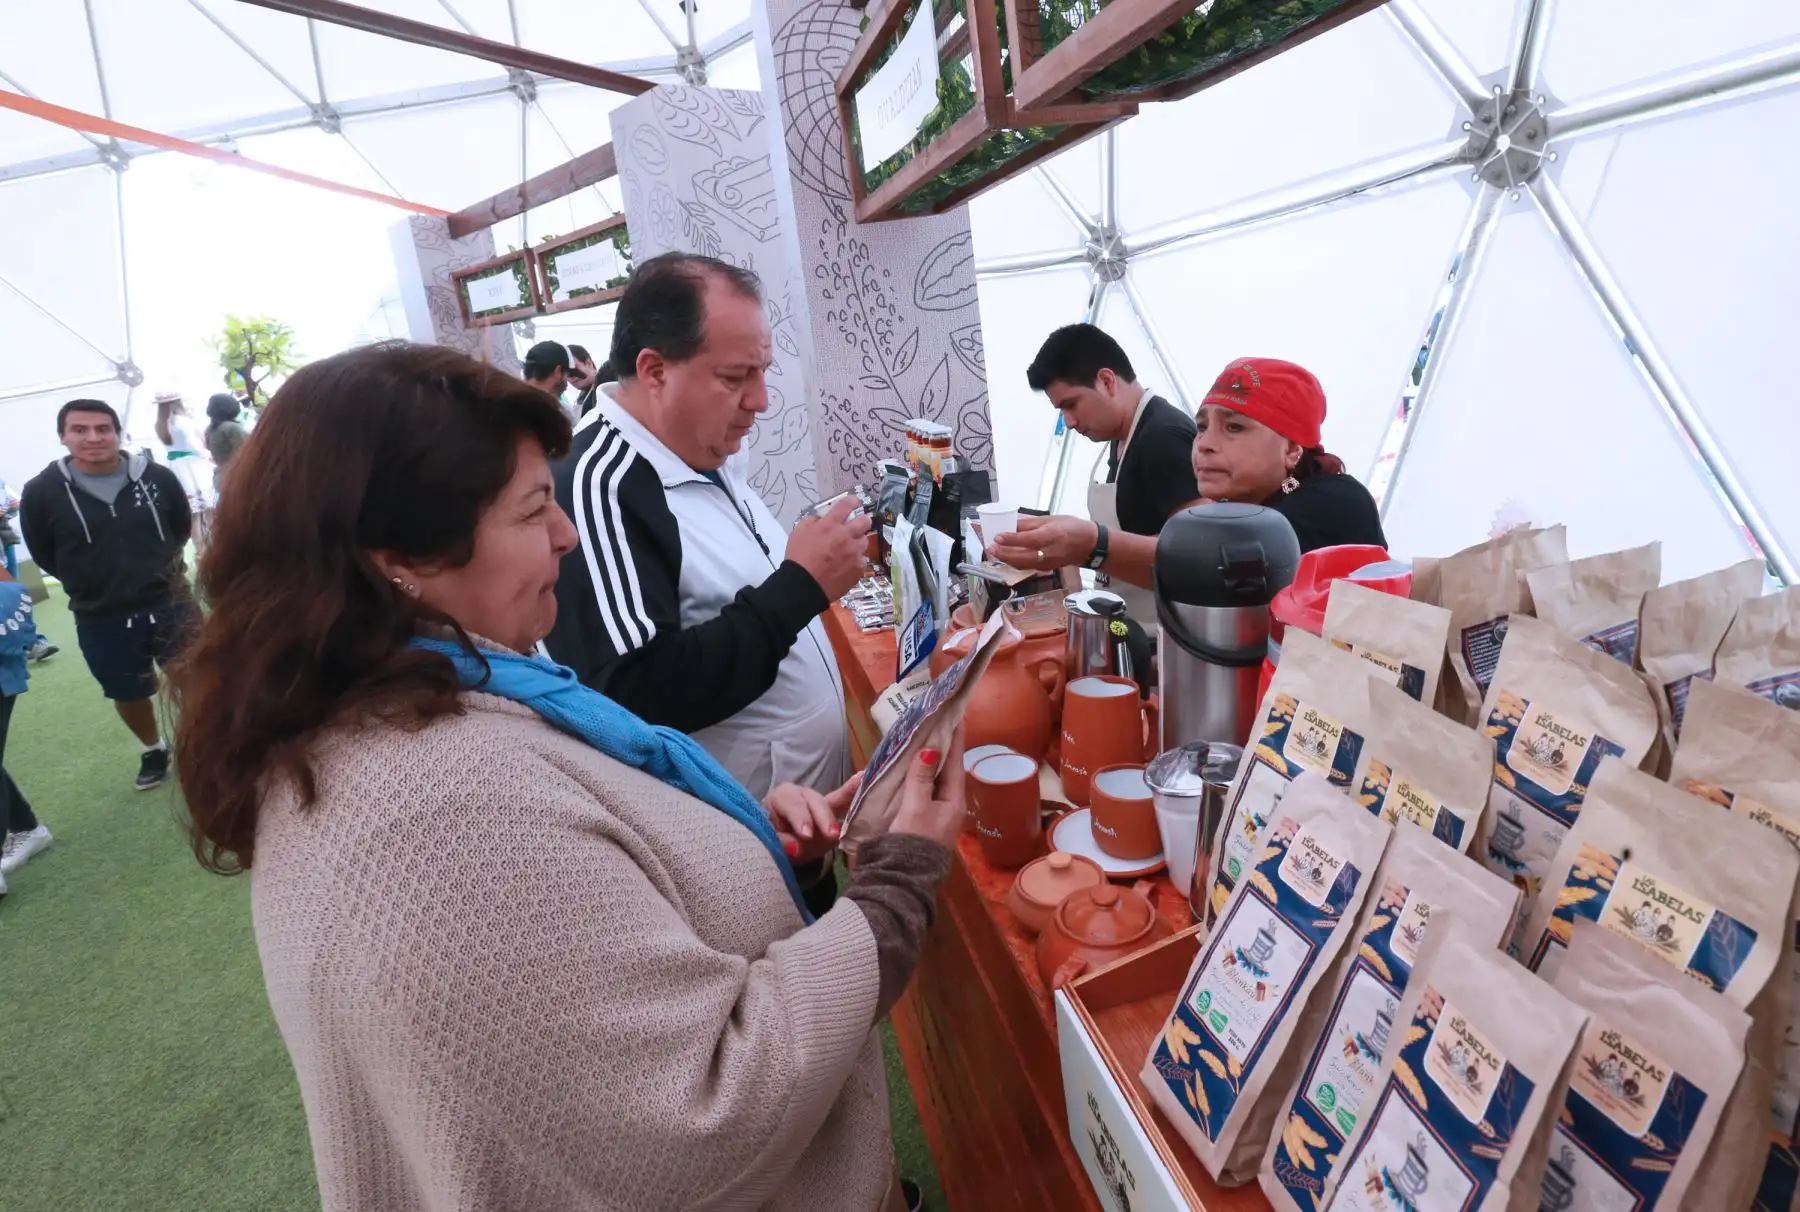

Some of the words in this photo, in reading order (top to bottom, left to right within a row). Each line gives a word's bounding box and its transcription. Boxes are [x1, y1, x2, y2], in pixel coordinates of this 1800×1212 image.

[904, 630, 913, 664] VISA
[1303, 711, 1340, 738] ISABELAS
[1534, 715, 1589, 748] ISABELAS
[1396, 783, 1435, 819] ISABELAS
[1301, 836, 1341, 869] ISABELAS
[1632, 878, 1706, 925] ISABELAS
[1450, 1017, 1500, 1071] ISABELAS
[1599, 1030, 1665, 1084] ISABELAS
